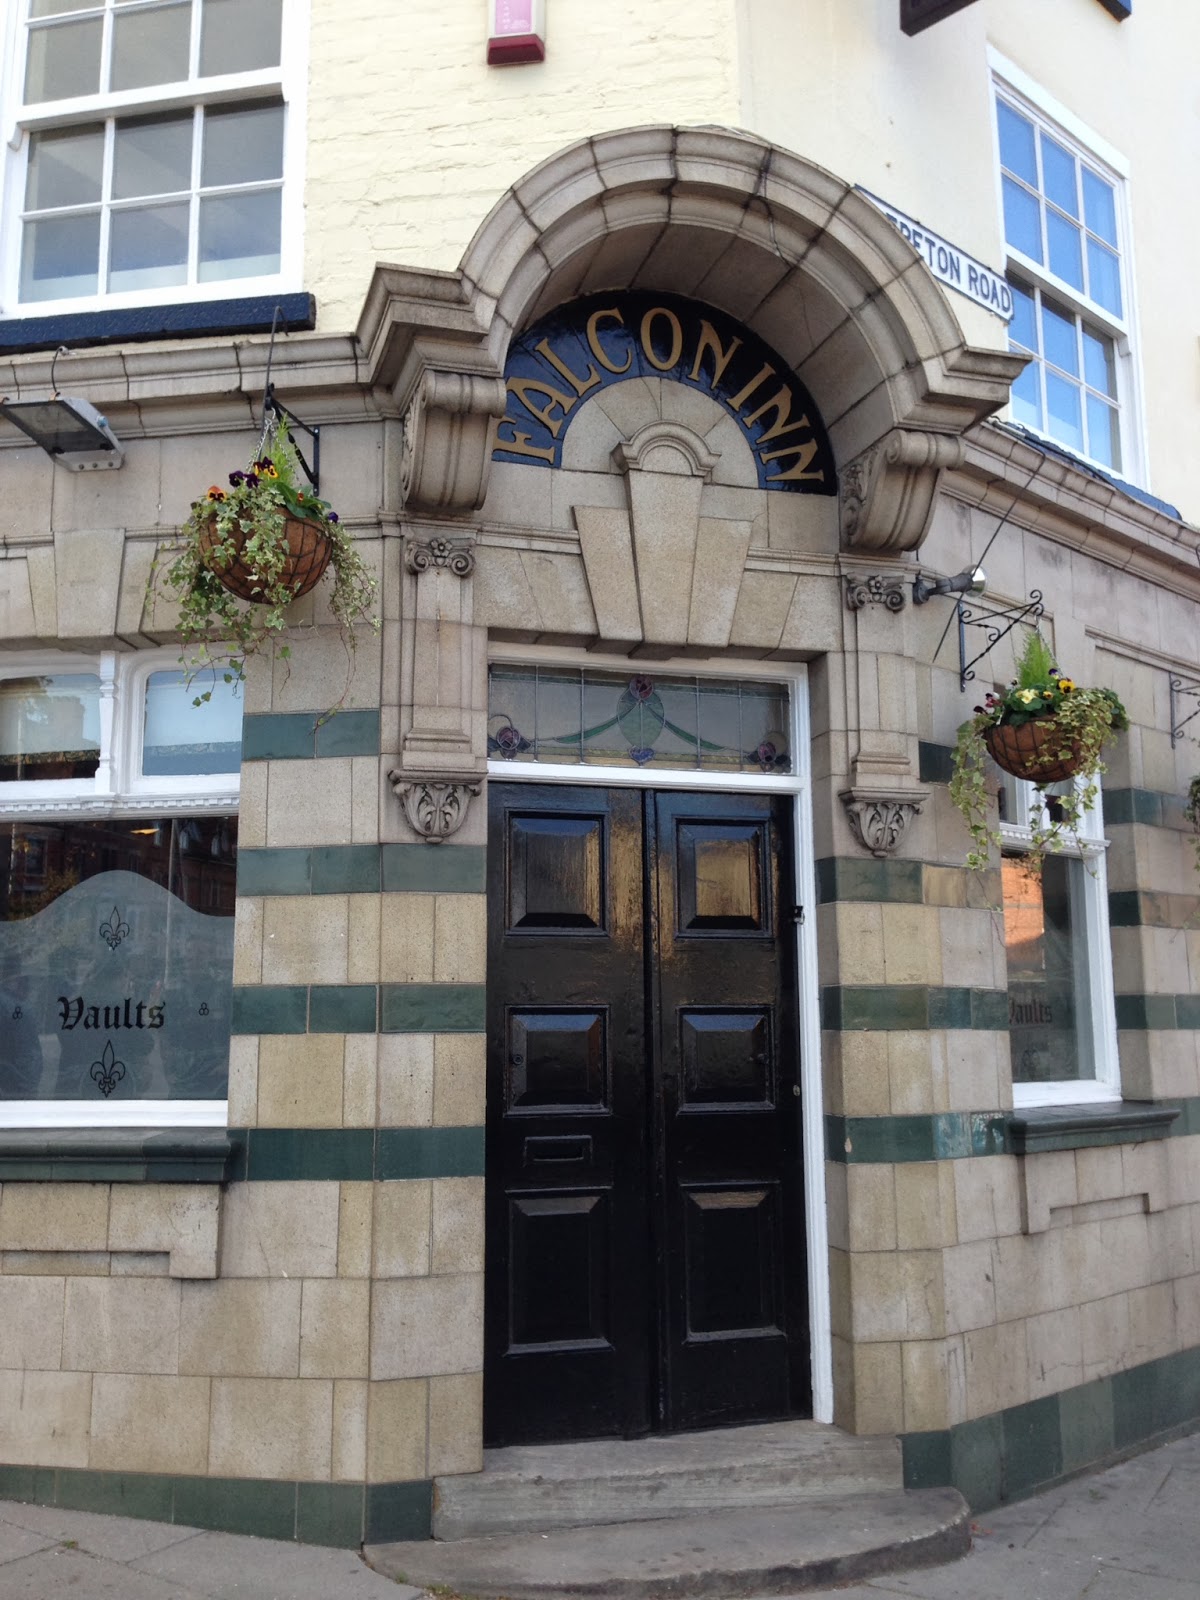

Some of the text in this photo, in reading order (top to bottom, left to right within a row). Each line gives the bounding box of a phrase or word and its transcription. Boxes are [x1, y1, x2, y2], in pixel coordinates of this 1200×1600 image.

[886, 212, 1011, 313] ETON ROAD
[493, 307, 824, 482] FALCON INN
[57, 996, 166, 1030] Vaults
